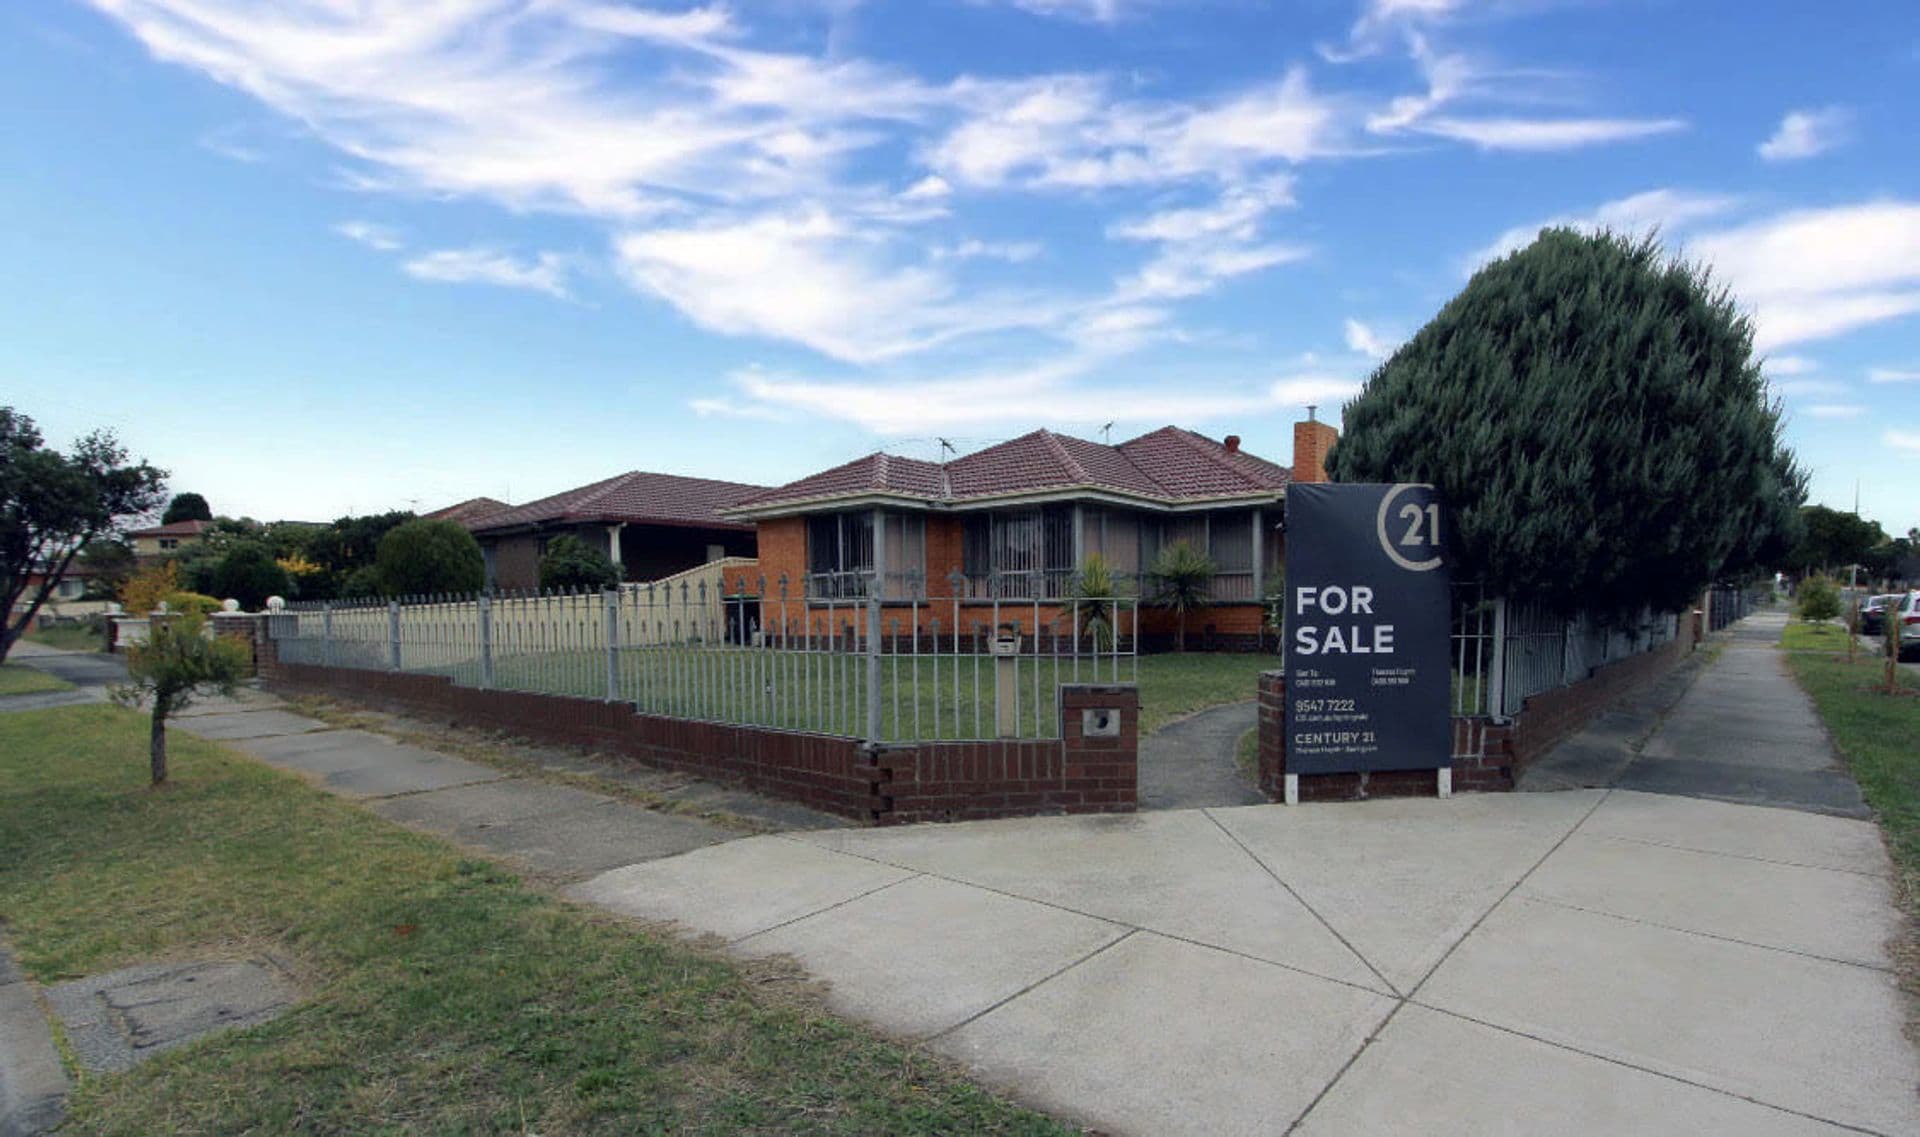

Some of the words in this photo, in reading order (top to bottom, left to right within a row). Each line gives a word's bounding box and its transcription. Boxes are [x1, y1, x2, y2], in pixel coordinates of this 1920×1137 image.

[1400, 503, 1440, 546] 21
[1297, 585, 1374, 615] FOR
[1296, 625, 1394, 655] SALE
[1295, 699, 1324, 713] 9547
[1326, 699, 1355, 711] 7222
[1295, 731, 1359, 744] CENTURY
